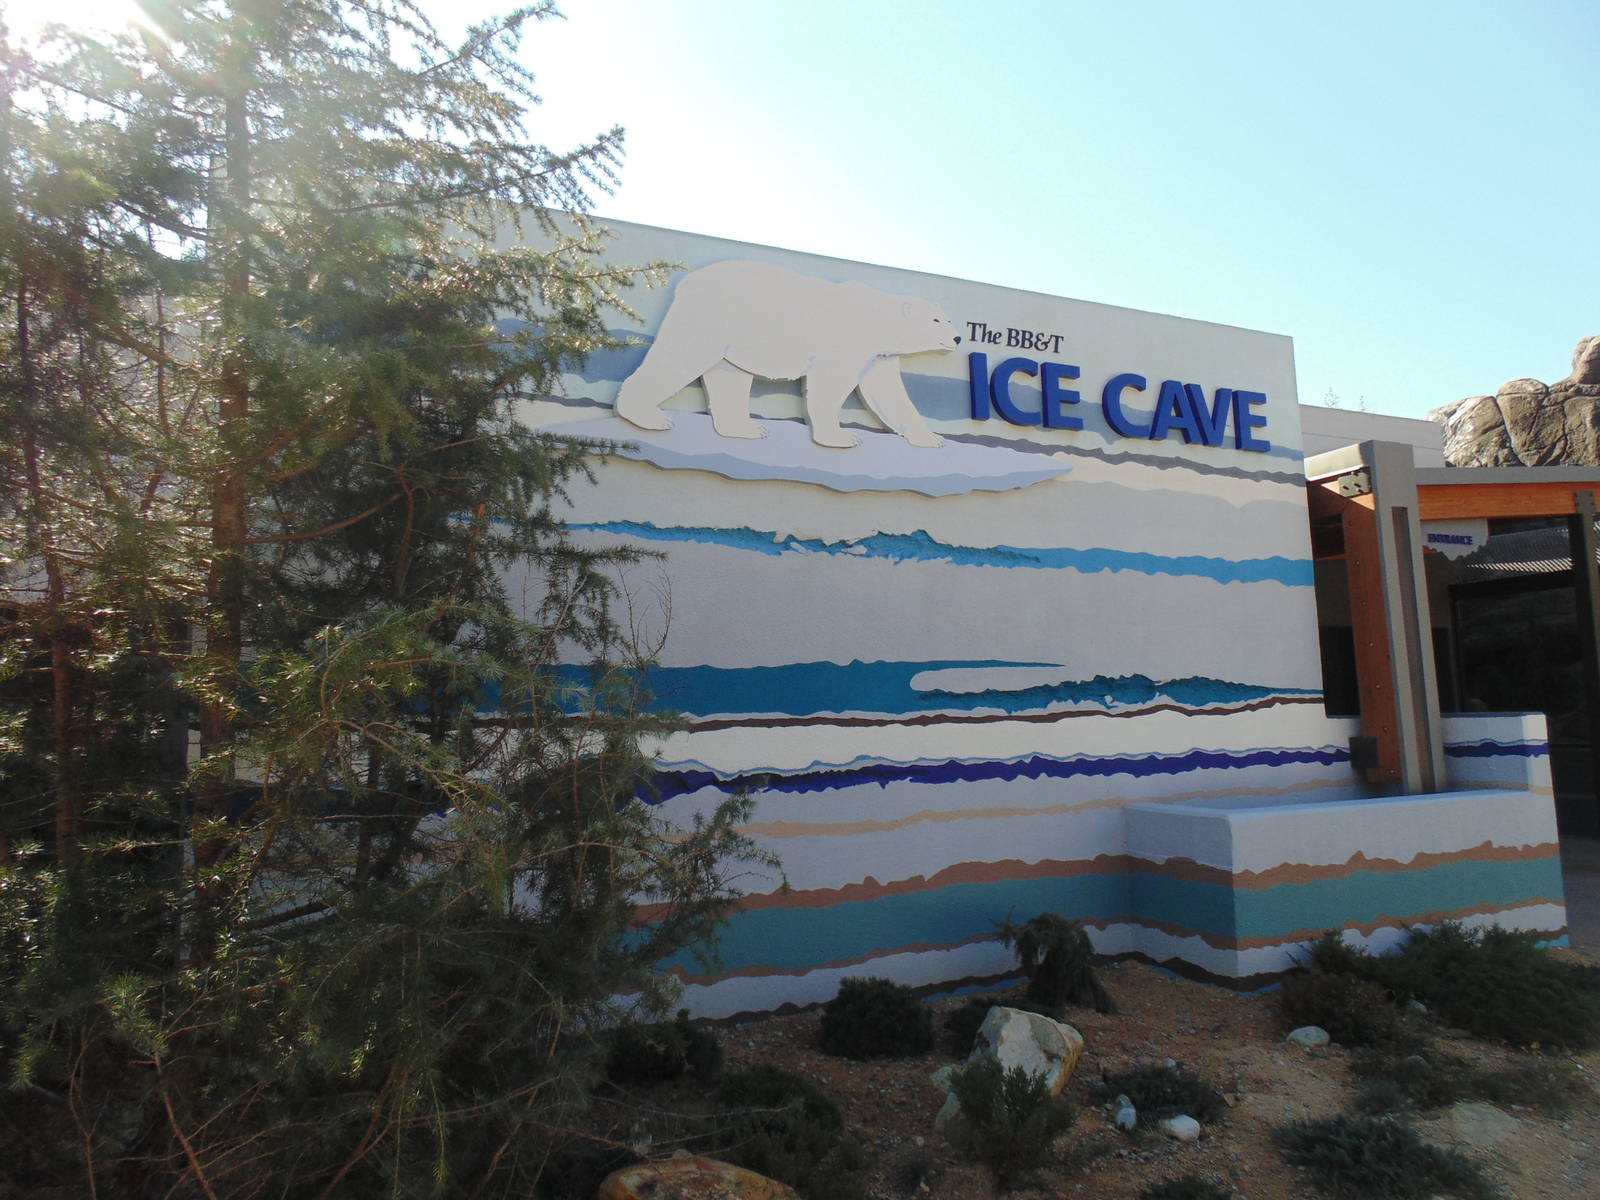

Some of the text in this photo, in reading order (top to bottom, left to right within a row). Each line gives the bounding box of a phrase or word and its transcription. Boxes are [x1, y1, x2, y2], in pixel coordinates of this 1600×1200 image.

[967, 321, 1064, 353] The BB&T
[968, 352, 1271, 452] ICE CAVE
[1427, 533, 1473, 545] ENTRANCE
